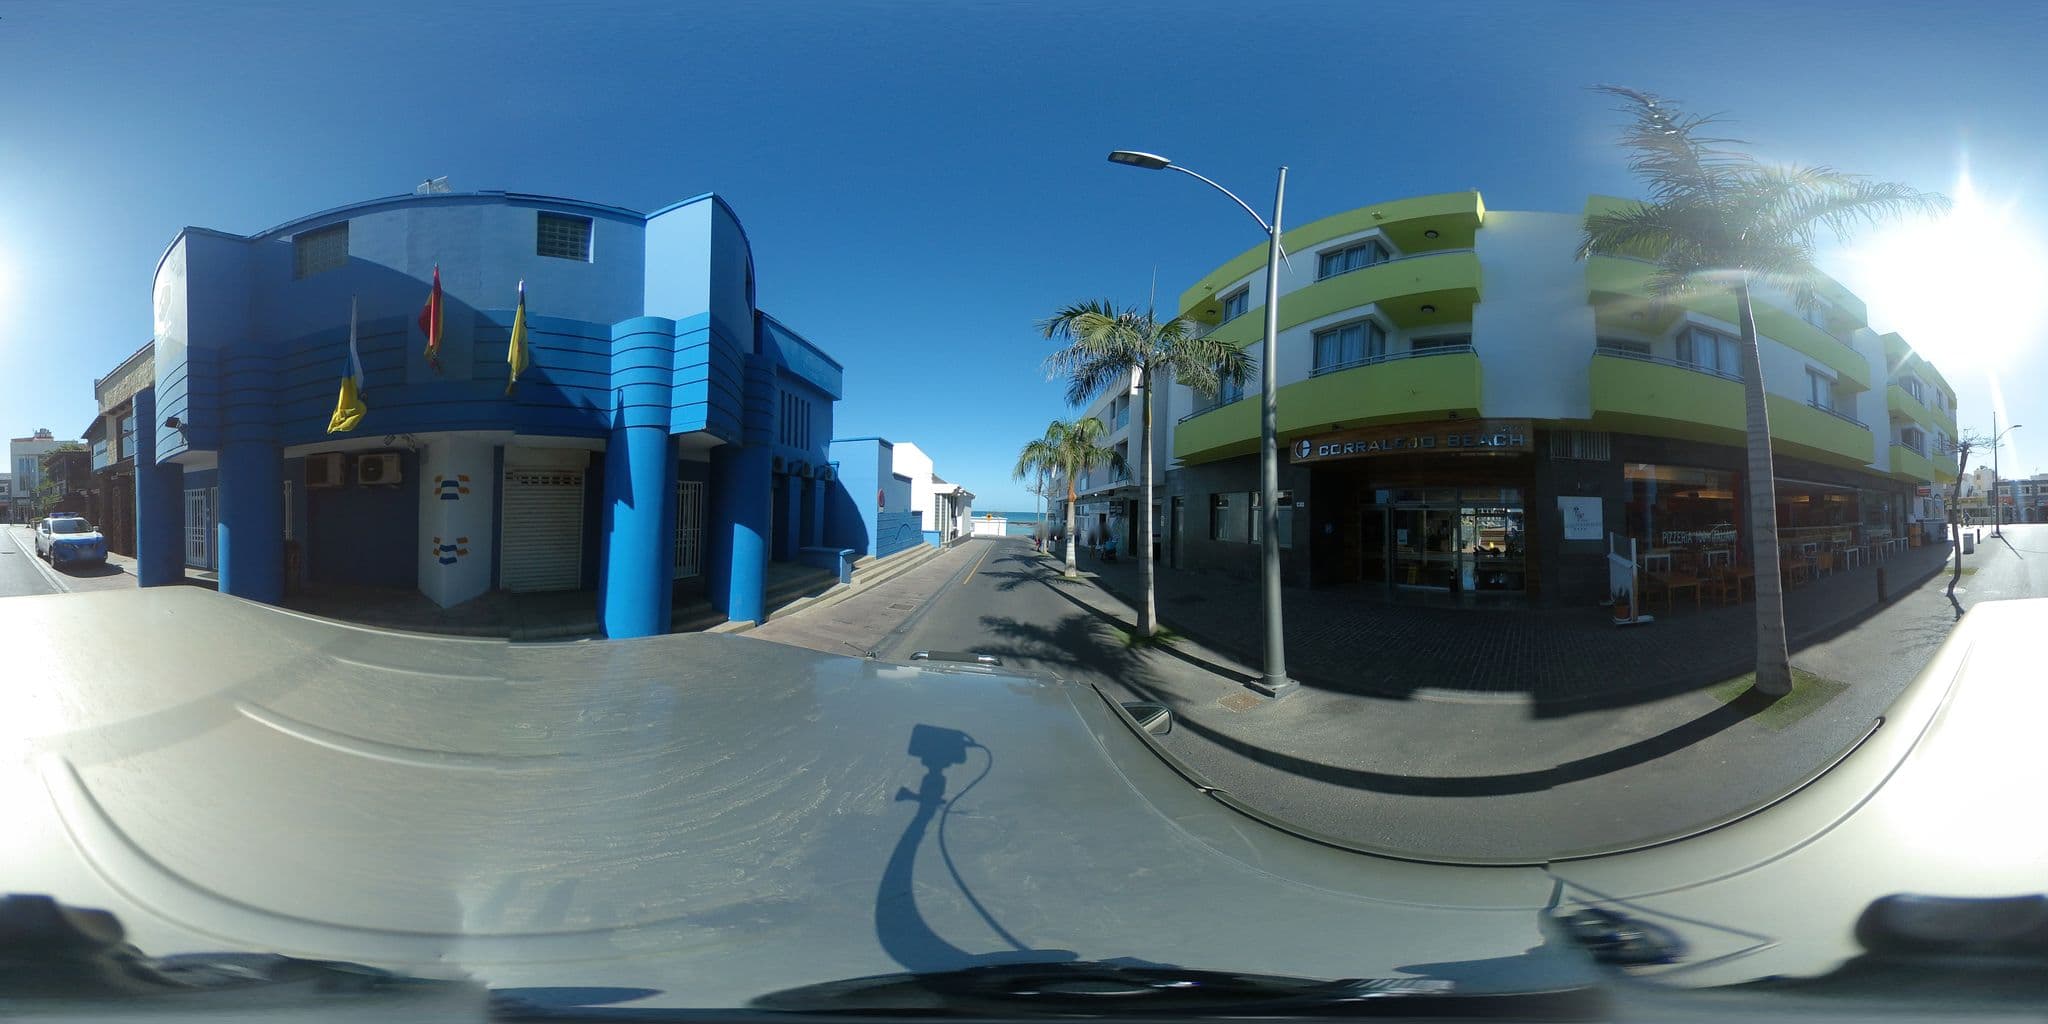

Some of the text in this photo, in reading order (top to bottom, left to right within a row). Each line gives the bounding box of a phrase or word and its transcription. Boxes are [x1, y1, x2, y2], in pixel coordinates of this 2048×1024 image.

[1319, 433, 1524, 456] CORRALEJO BEACH
[1662, 531, 1693, 545] PIZZERIA
